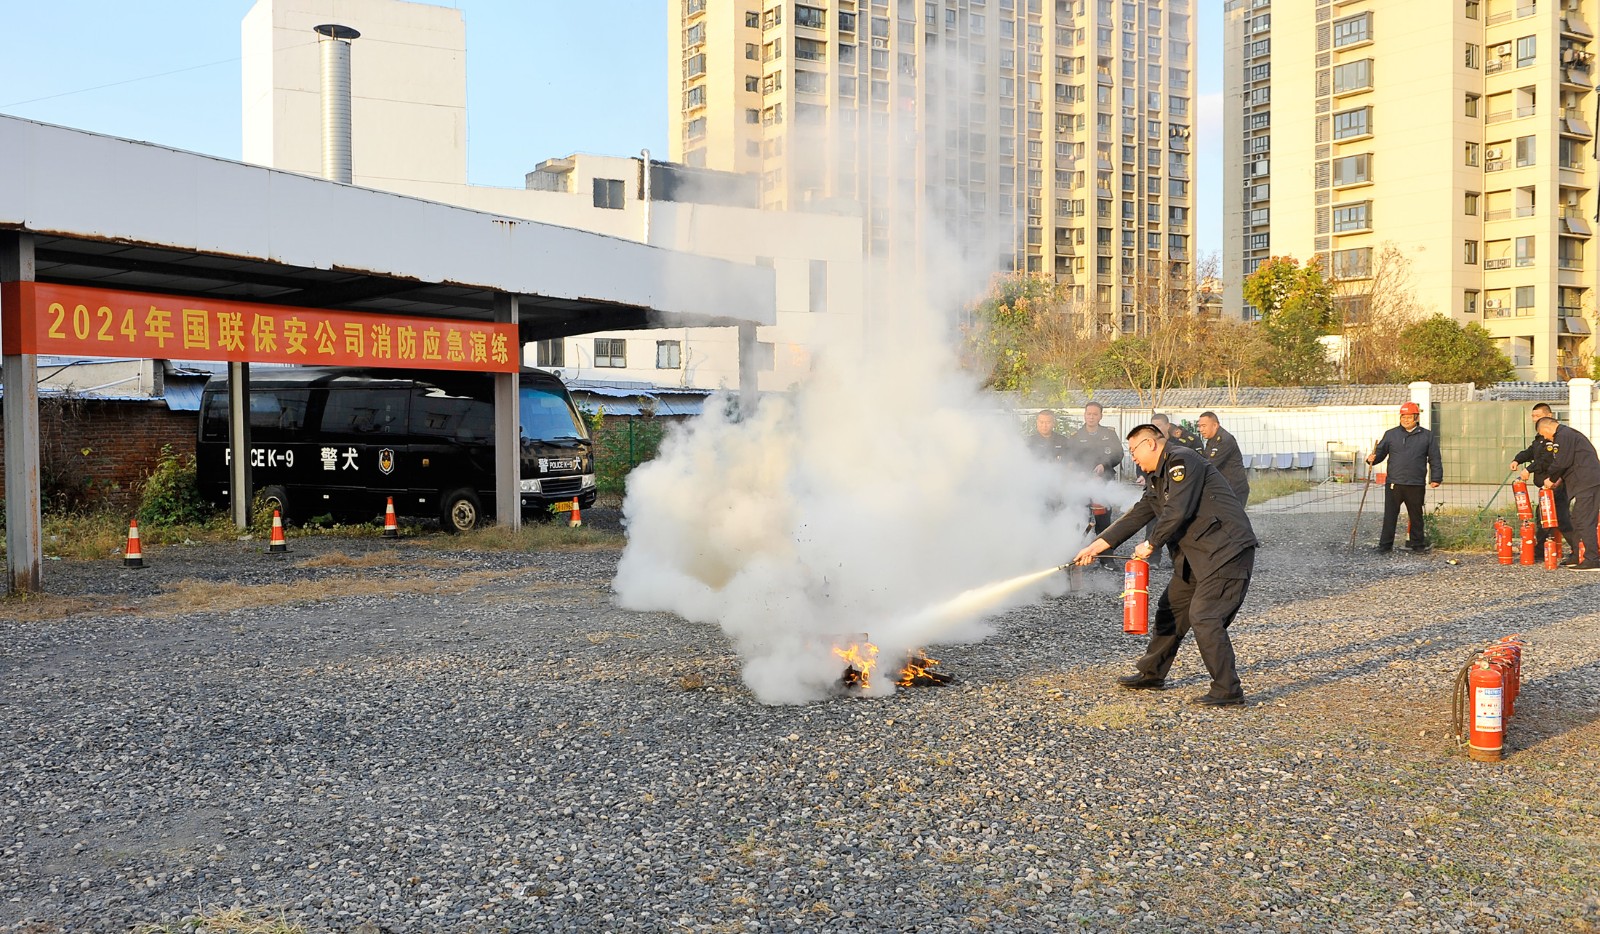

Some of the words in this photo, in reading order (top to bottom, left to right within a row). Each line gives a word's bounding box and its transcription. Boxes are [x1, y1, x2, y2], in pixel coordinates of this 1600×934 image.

[48, 302, 509, 365] 2024年国联保安公司消防应急演练
[225, 448, 265, 467] PCE
[267, 449, 294, 468] K-9
[320, 447, 359, 471] 警犬
